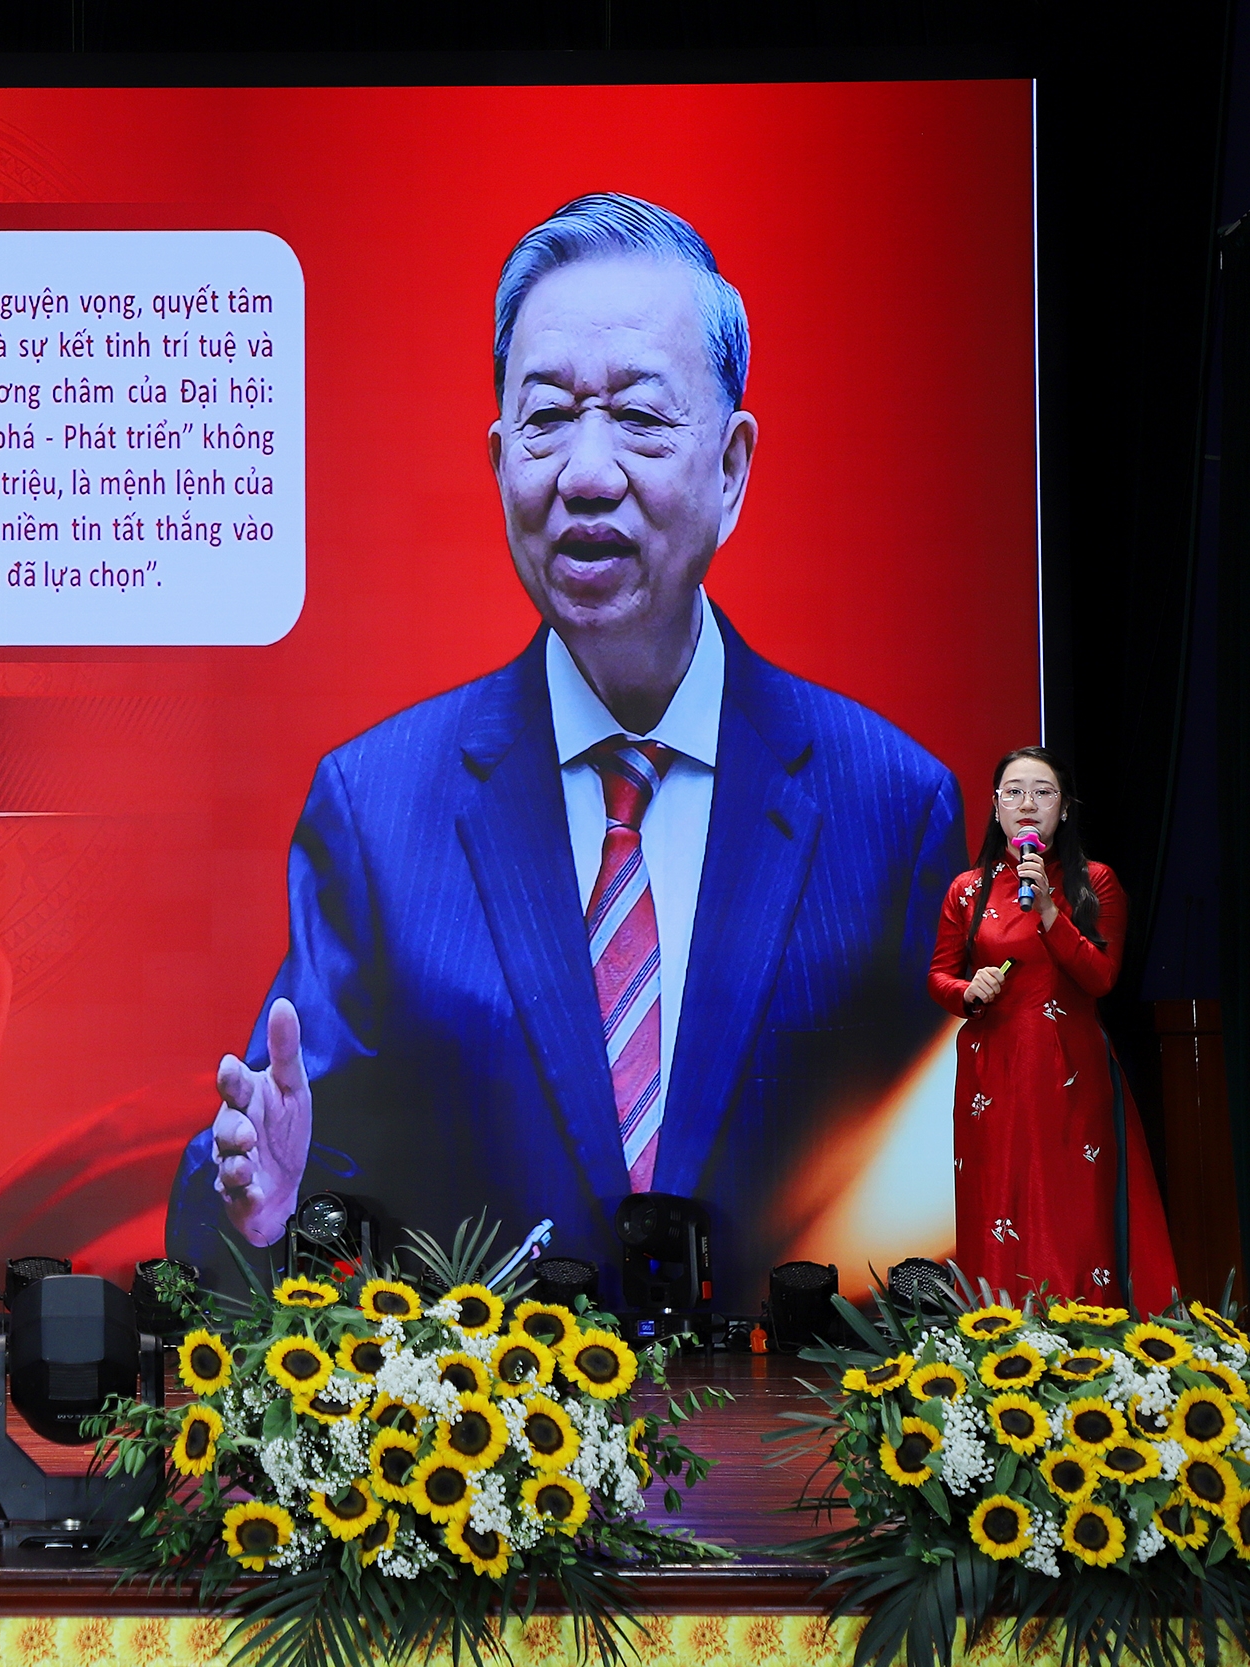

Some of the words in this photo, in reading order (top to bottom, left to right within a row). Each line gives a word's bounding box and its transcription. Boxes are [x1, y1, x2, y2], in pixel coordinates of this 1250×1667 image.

[79, 294, 143, 320] vọng,
[152, 283, 220, 320] quyết
[227, 286, 273, 314] tâm
[19, 336, 49, 364] sự
[59, 327, 95, 358] kết
[105, 331, 151, 358] tinh
[162, 330, 189, 358] trí
[198, 330, 237, 364] tuệ
[247, 330, 273, 358] và
[52, 376, 114, 404] châm
[128, 374, 167, 404] của
[179, 377, 217, 410] Đại
[230, 376, 273, 410] hội:
[64, 422, 117, 450] Phát
[125, 418, 194, 450] triển”
[203, 422, 275, 456] không
[1, 468, 63, 502] triệu,
[72, 468, 91, 496] là
[100, 468, 166, 502] mệnh
[176, 468, 226, 502] lệnh
[234, 466, 274, 495] của
[2, 511, 59, 541] niềm
[71, 515, 102, 541] tin
[111, 511, 145, 541] tất
[155, 509, 223, 548] thắng
[232, 514, 274, 541] vào
[7, 560, 36, 588] đã
[44, 560, 82, 593] lựa
[89, 560, 162, 593] chọn”.
